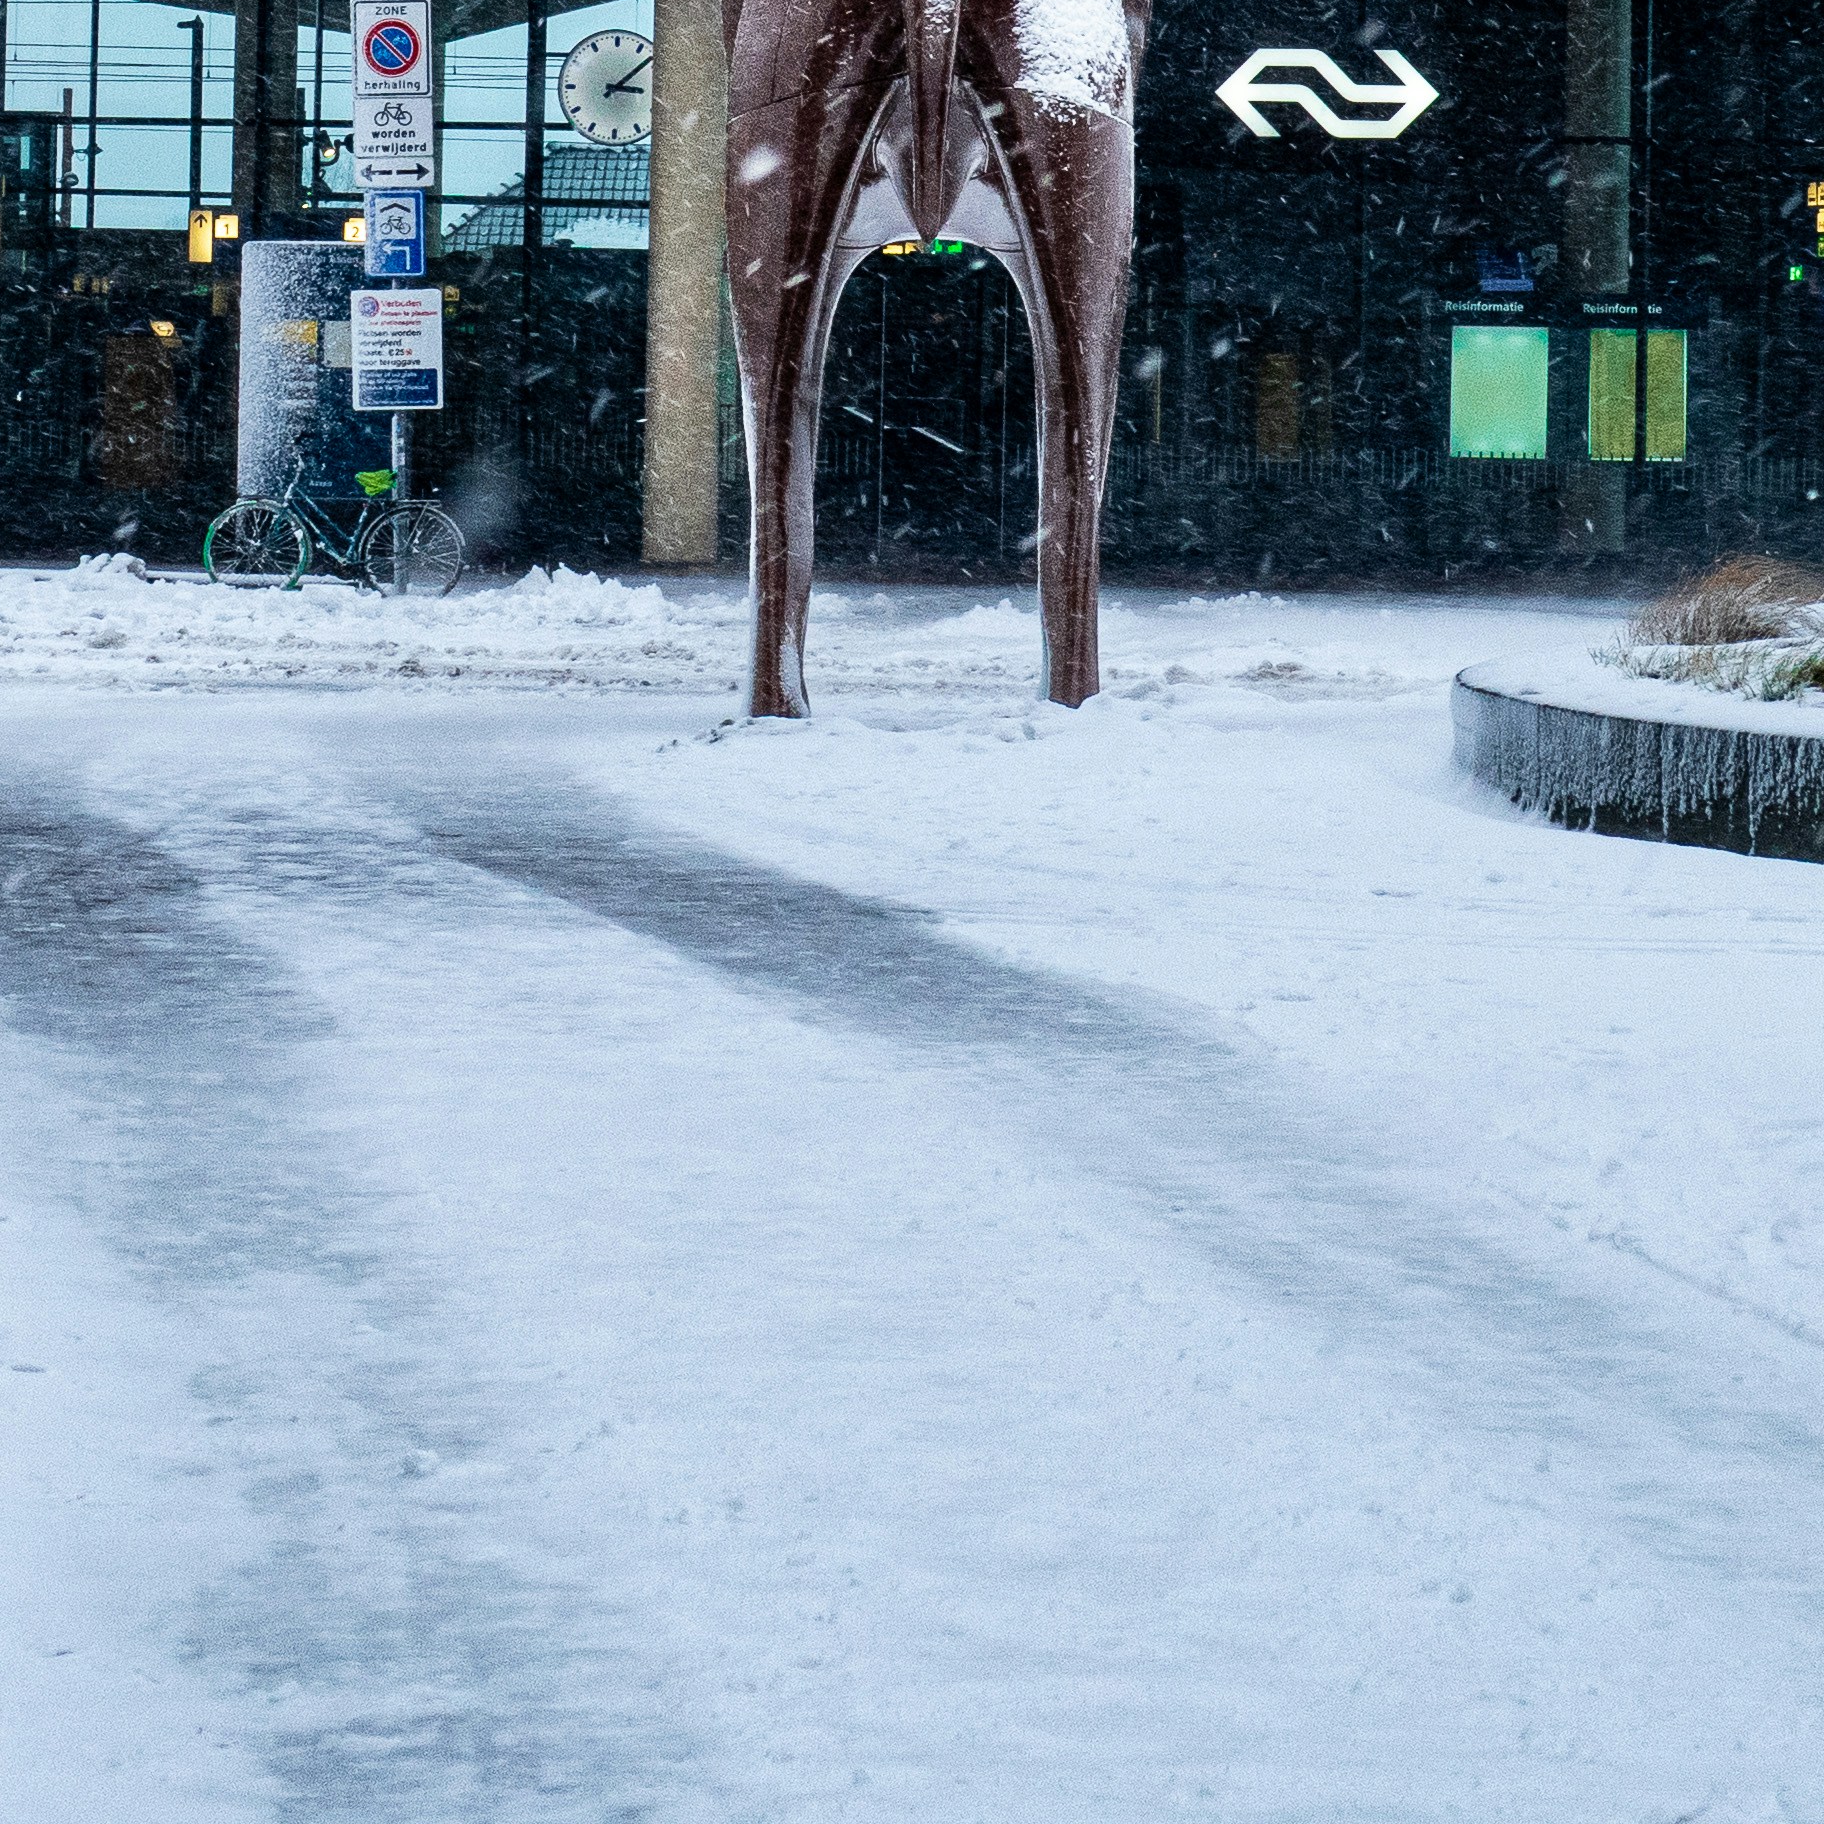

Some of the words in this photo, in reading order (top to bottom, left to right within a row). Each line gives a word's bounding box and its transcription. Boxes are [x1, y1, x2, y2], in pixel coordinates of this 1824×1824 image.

[375, 6, 407, 16] ZONE
[364, 80, 421, 91] herhaling
[371, 129, 416, 139] worden
[361, 142, 427, 156] verwijderd
[223, 223, 229, 235] 1
[352, 226, 359, 238] 2
[1445, 301, 1524, 313] Reisinformatie
[391, 329, 422, 337] worden
